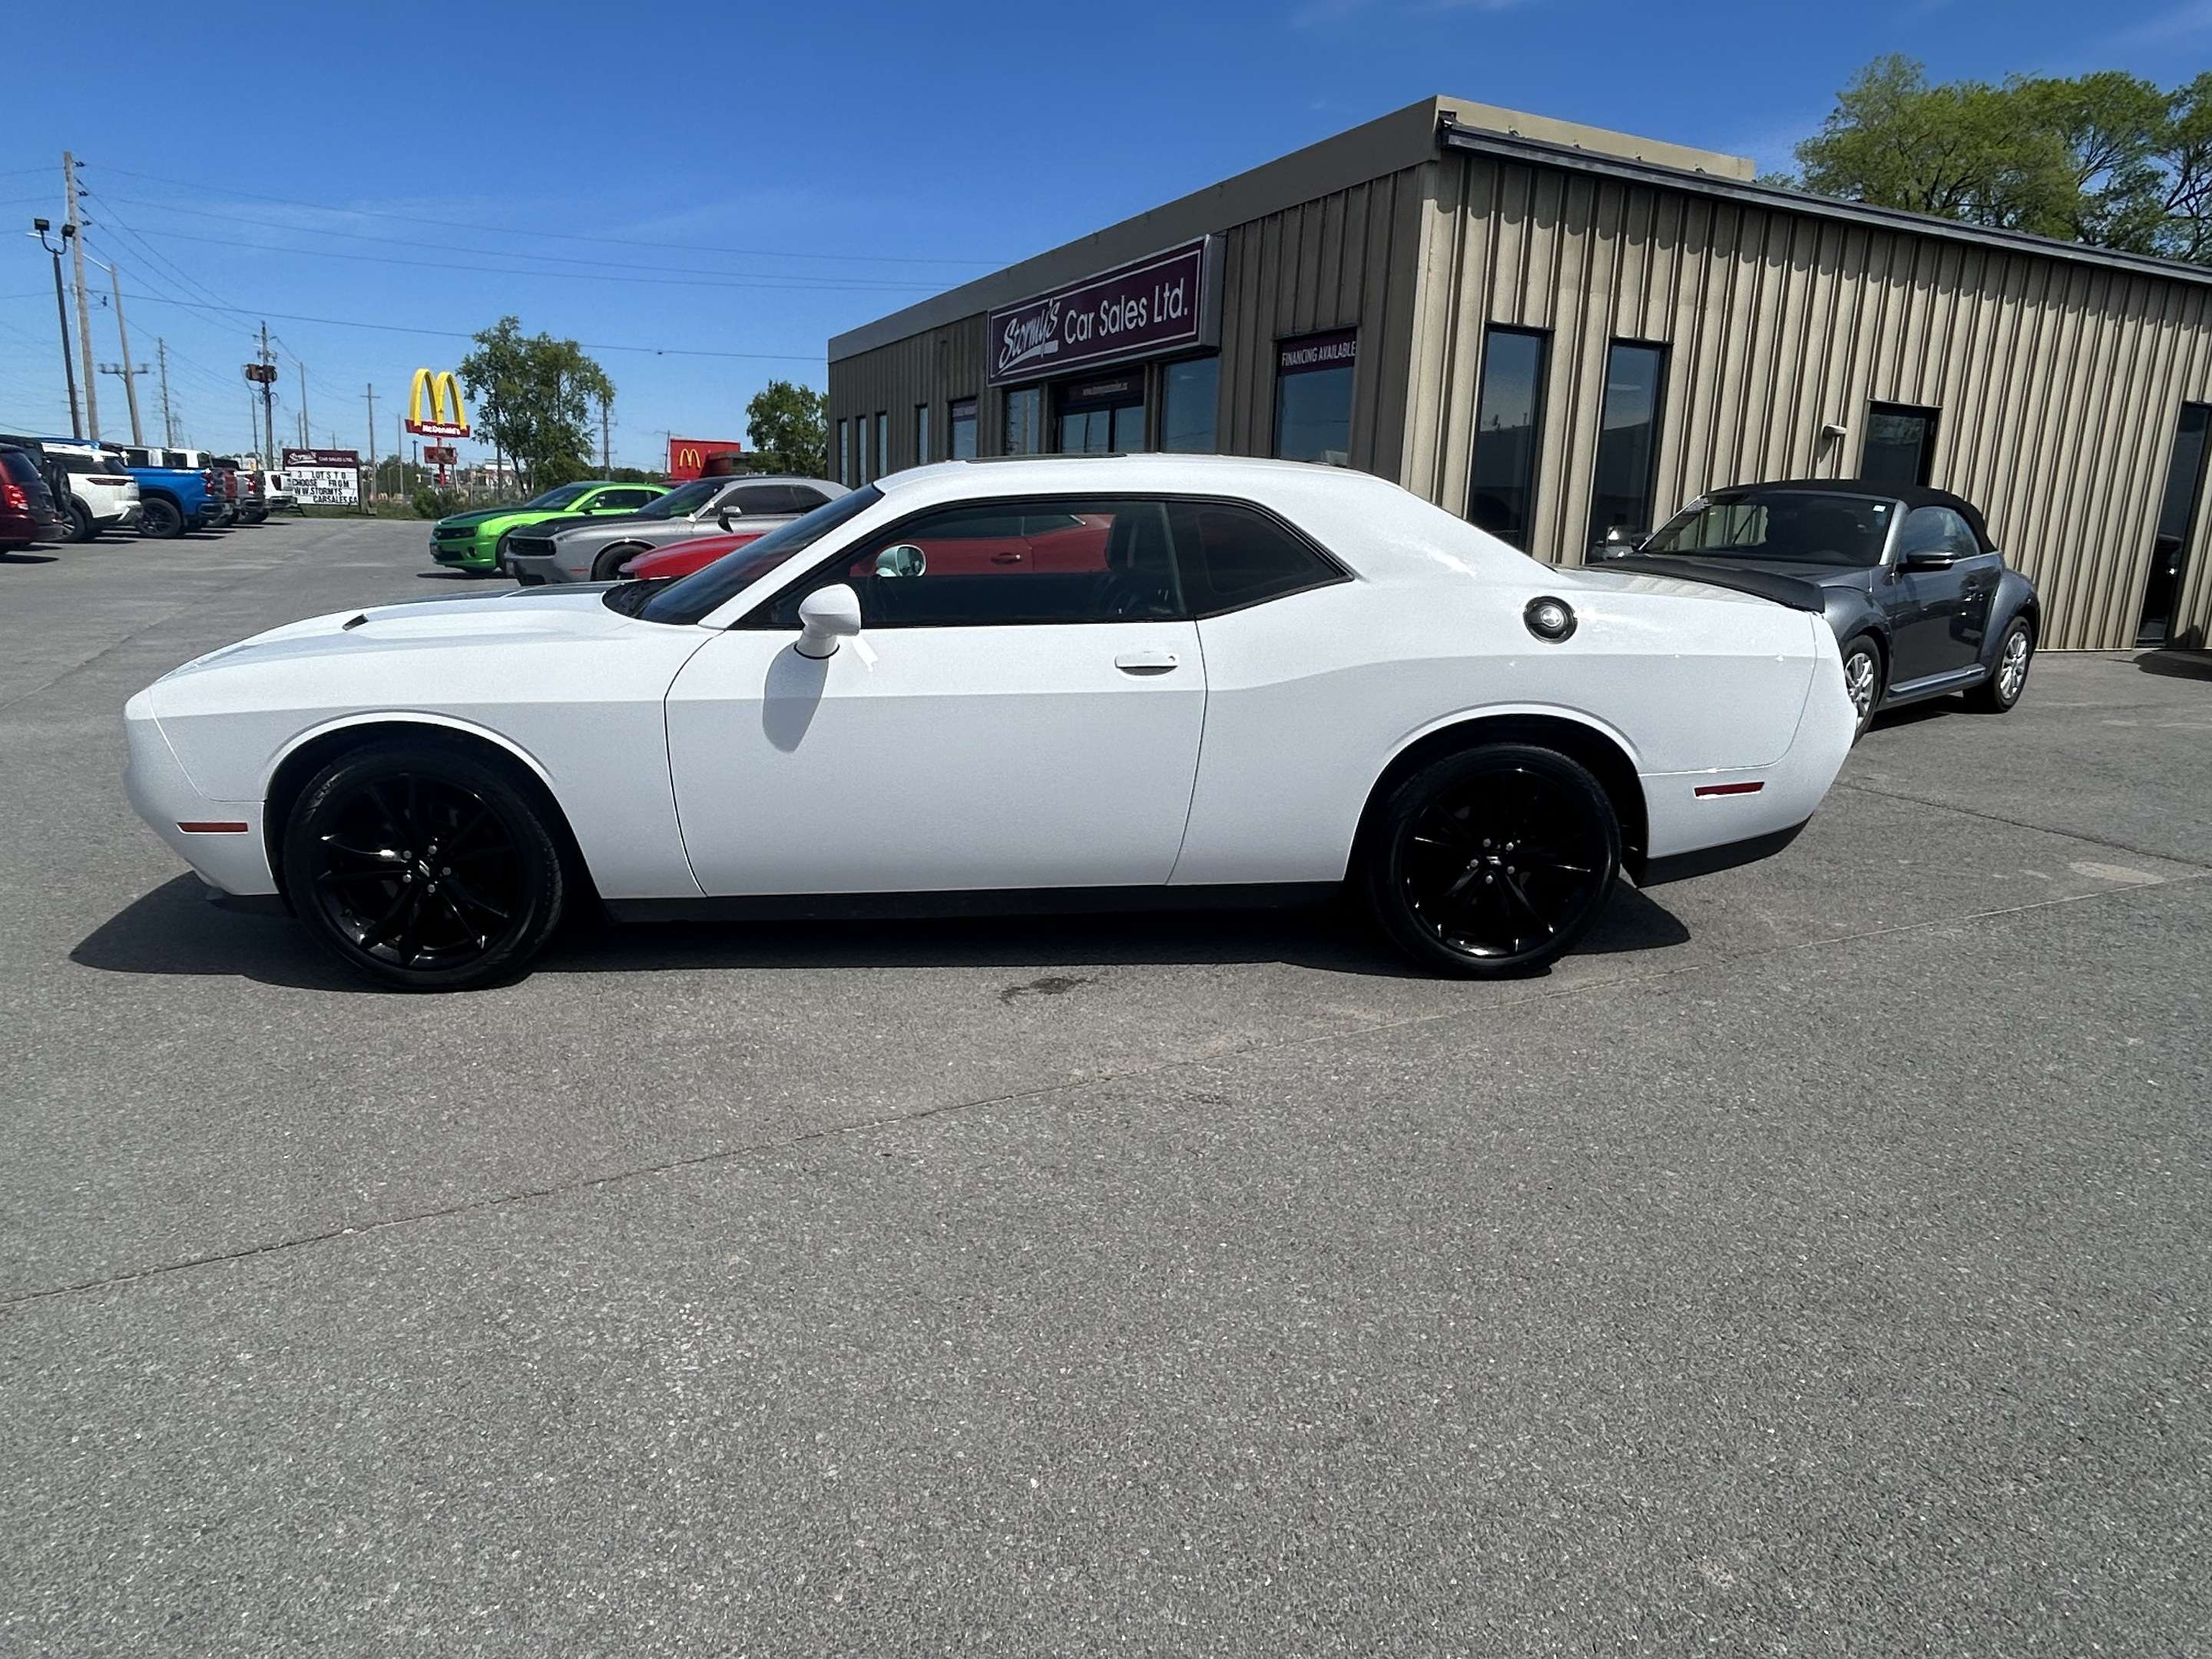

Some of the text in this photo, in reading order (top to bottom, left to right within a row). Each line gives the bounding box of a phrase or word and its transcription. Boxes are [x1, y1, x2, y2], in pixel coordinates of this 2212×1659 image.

[998, 277, 1188, 369] Stormy's Car Sales Ltd.
[1281, 341, 1356, 366] FINANCING AVAILABLE
[297, 470, 303, 478] 3
